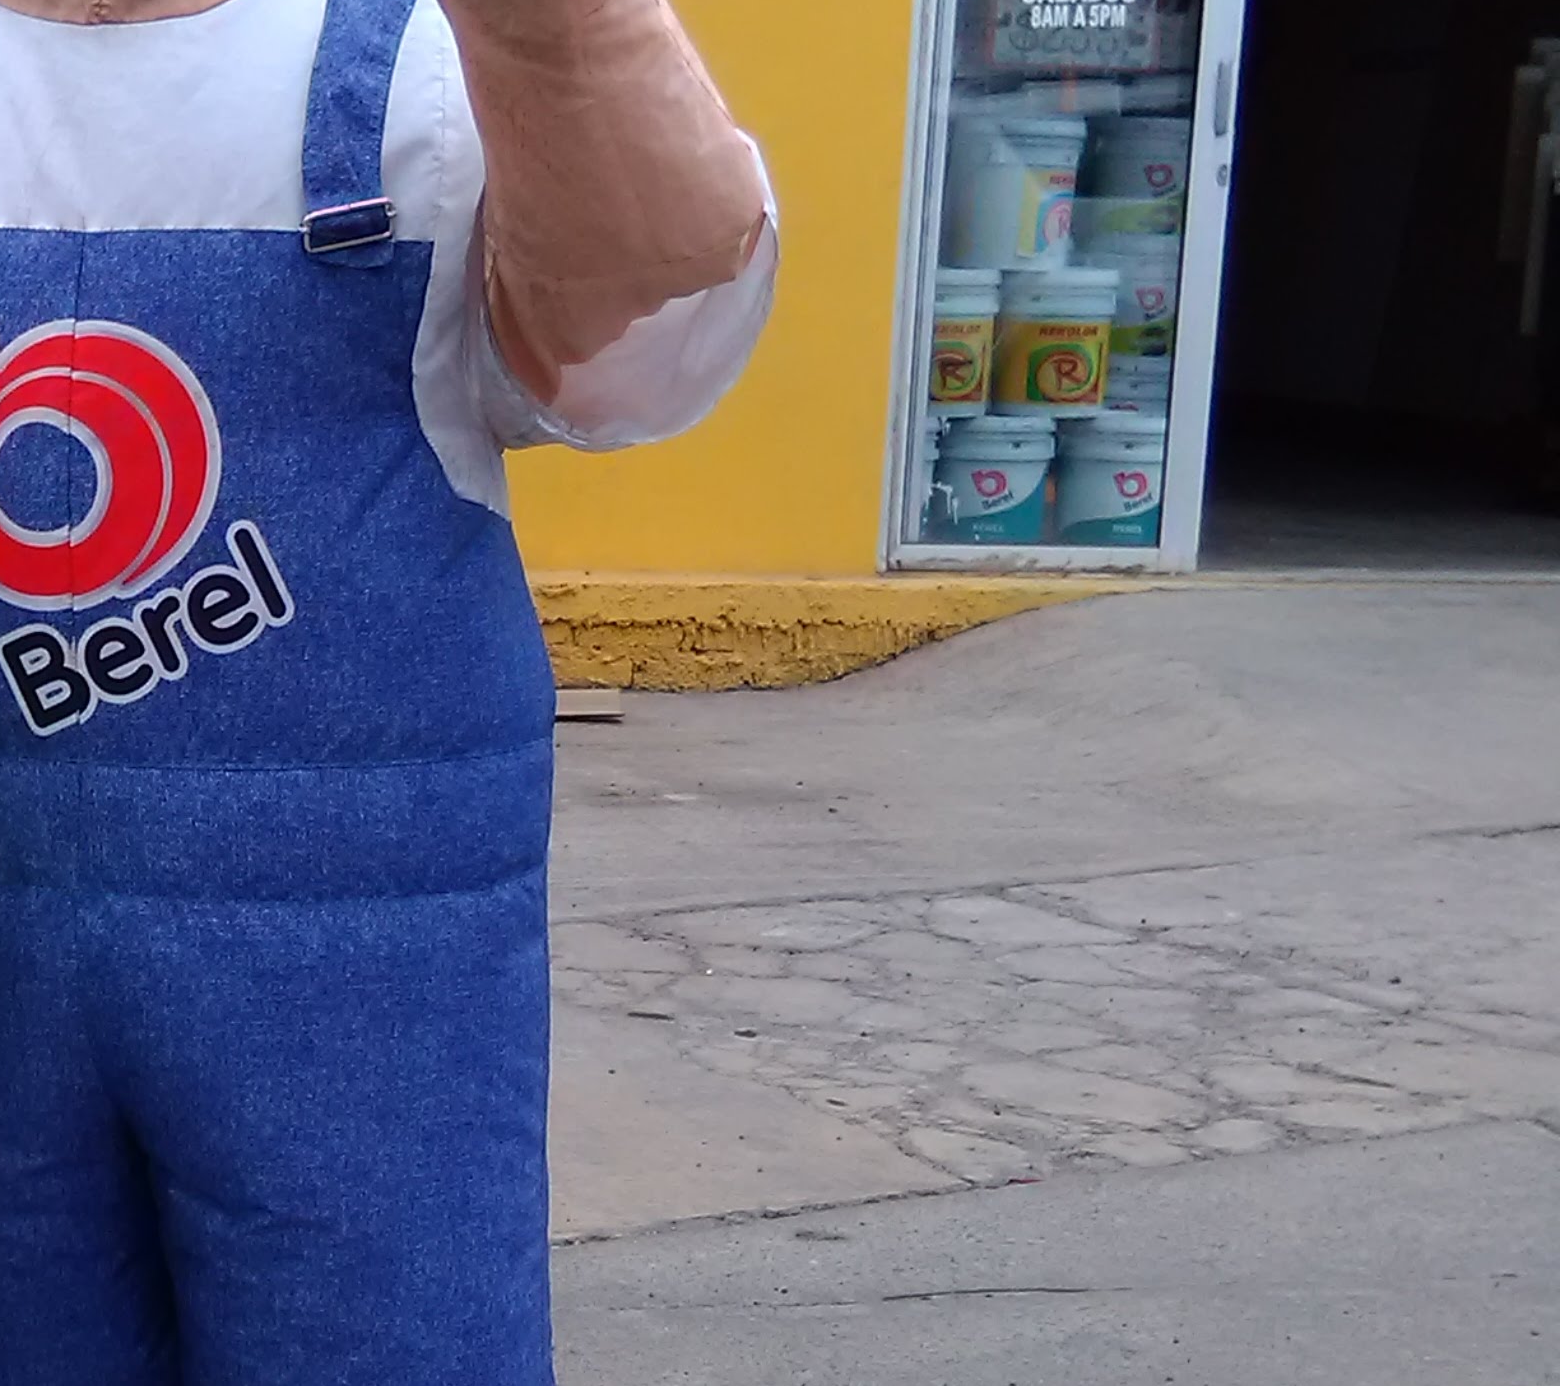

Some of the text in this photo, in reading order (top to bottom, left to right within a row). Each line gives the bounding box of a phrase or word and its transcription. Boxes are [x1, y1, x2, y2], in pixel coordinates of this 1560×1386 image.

[1030, 4, 1127, 29] 8AM A 5PM
